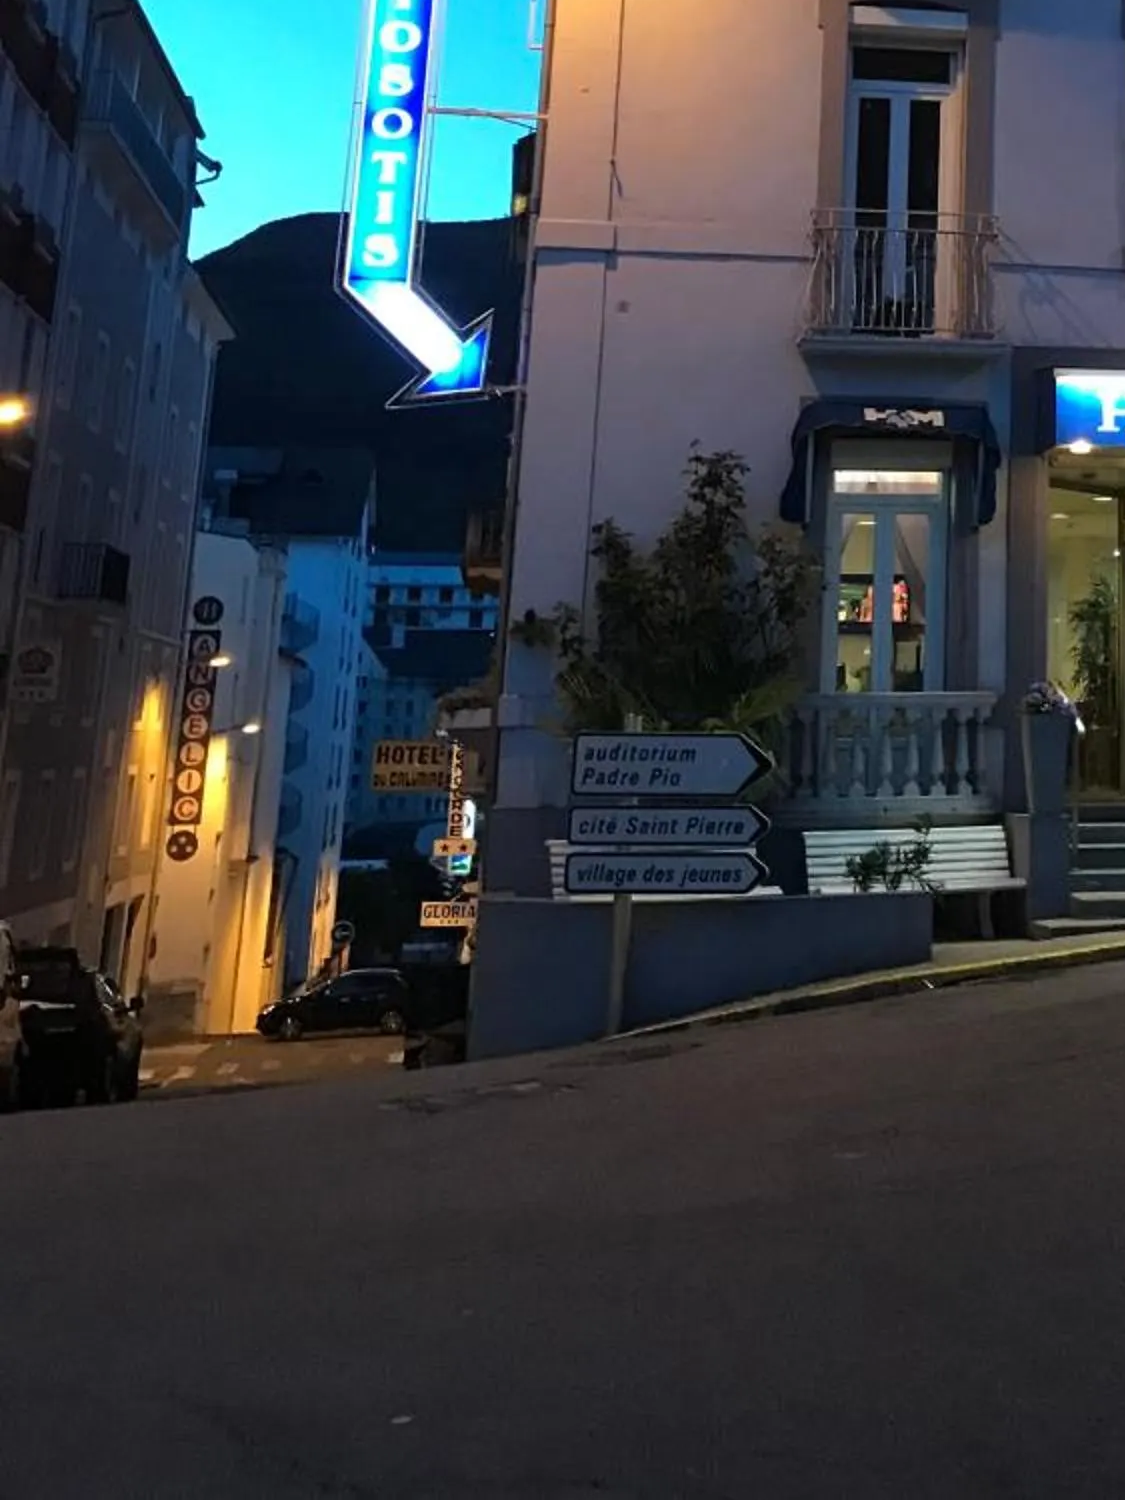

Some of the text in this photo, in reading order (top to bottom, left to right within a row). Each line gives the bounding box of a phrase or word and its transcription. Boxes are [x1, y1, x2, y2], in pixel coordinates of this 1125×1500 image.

[376, 745, 441, 765] HOTEL
[584, 743, 697, 764] auditorium
[581, 767, 681, 786] Padre Pio
[579, 815, 745, 835] cité Saint Pierre
[577, 862, 743, 887] village des jeunes
[423, 904, 475, 919] GLORIA
